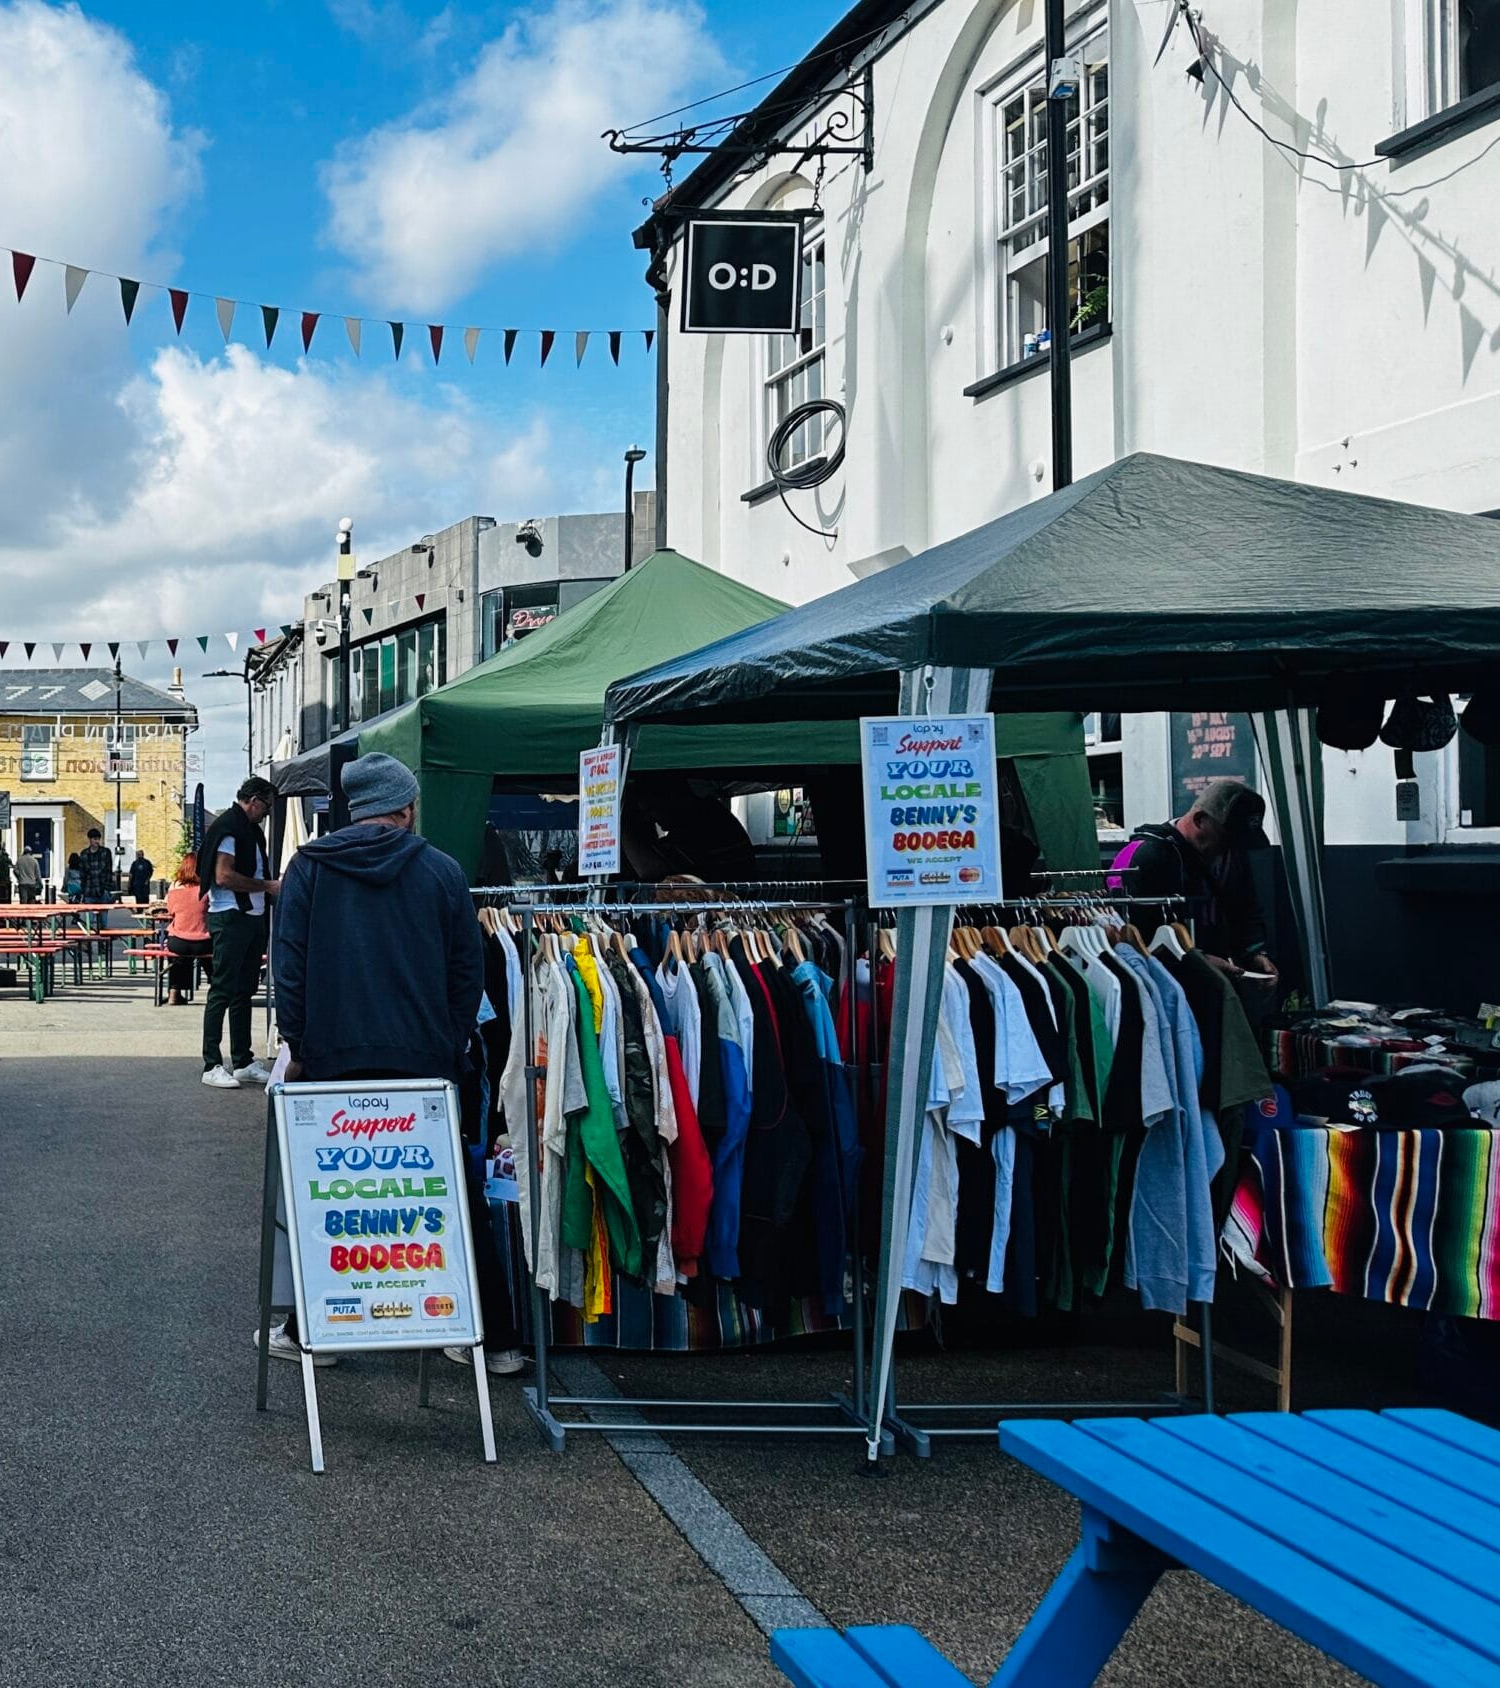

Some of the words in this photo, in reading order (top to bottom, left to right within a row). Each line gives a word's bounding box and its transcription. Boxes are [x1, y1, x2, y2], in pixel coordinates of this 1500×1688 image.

[708, 262, 777, 290] O:D
[5, 686, 66, 700] 77
[895, 734, 963, 757] Support
[887, 760, 974, 779] YOUR
[880, 782, 982, 800] LOCALE
[890, 804, 979, 827] BENNY'S
[893, 830, 976, 852] BODEGA
[925, 855, 962, 863] ACCEPT
[348, 1096, 388, 1111] lapay
[326, 1109, 417, 1141] Support
[315, 1145, 434, 1171] YOUR
[308, 1177, 448, 1200] LOCALE
[325, 1206, 445, 1239] BENNY'S
[329, 1243, 447, 1274] BODEGA
[350, 1281, 373, 1290] WE
[376, 1279, 426, 1290] ACCEPT
[332, 1305, 357, 1315] PUTA
